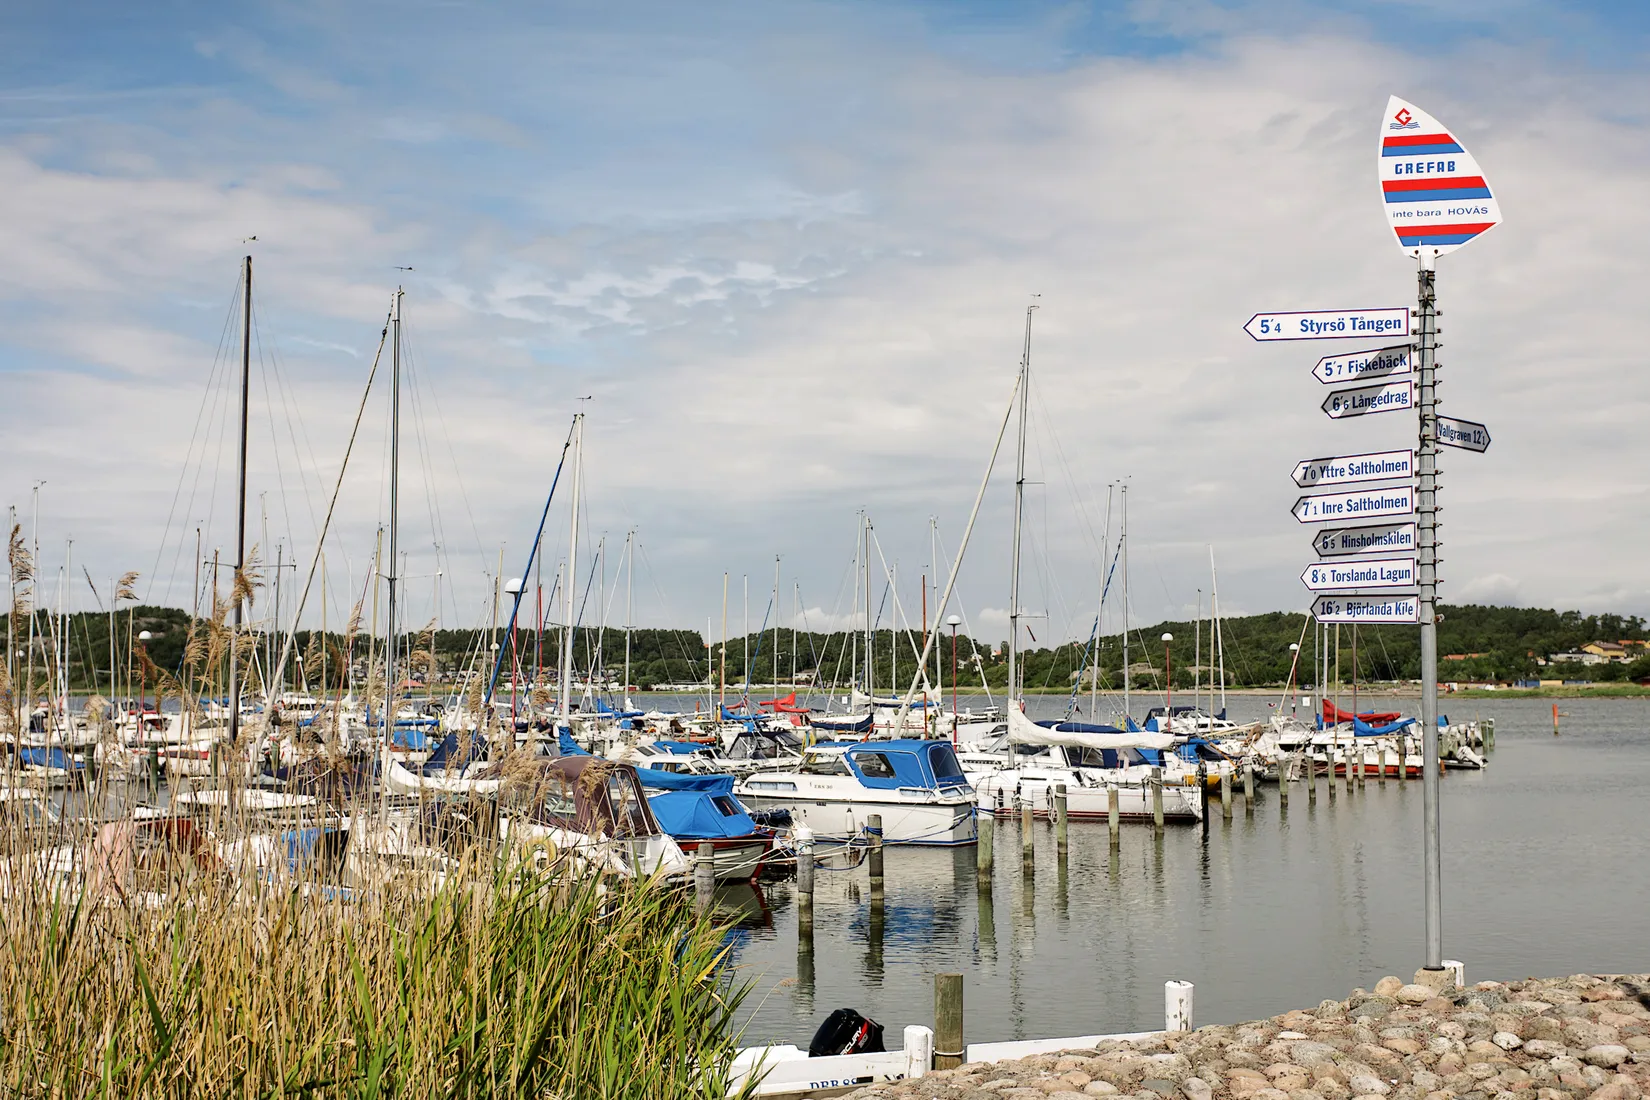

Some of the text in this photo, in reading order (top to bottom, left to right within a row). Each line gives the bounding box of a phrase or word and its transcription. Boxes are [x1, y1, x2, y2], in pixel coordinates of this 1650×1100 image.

[1394, 160, 1456, 175] GREFAB
[1392, 205, 1488, 218] inte bara HOVÅS
[1300, 318, 1345, 335] Styrsö
[1350, 316, 1402, 333] Tången
[1348, 353, 1407, 374] Fiskebäck
[1351, 389, 1408, 409] Långedrag
[1438, 422, 1472, 442] Vallgraven
[1319, 463, 1346, 479] Yttre
[1348, 459, 1408, 476] Saltholmen
[1322, 500, 1343, 514] Inre
[1346, 495, 1408, 513] Saltholmen
[1341, 531, 1411, 549] Hinsholmskilen
[1330, 567, 1378, 583] Torslanda
[1380, 566, 1411, 582] Lagun
[1346, 600, 1392, 618] Björlanda
[1395, 601, 1414, 616] Kile
